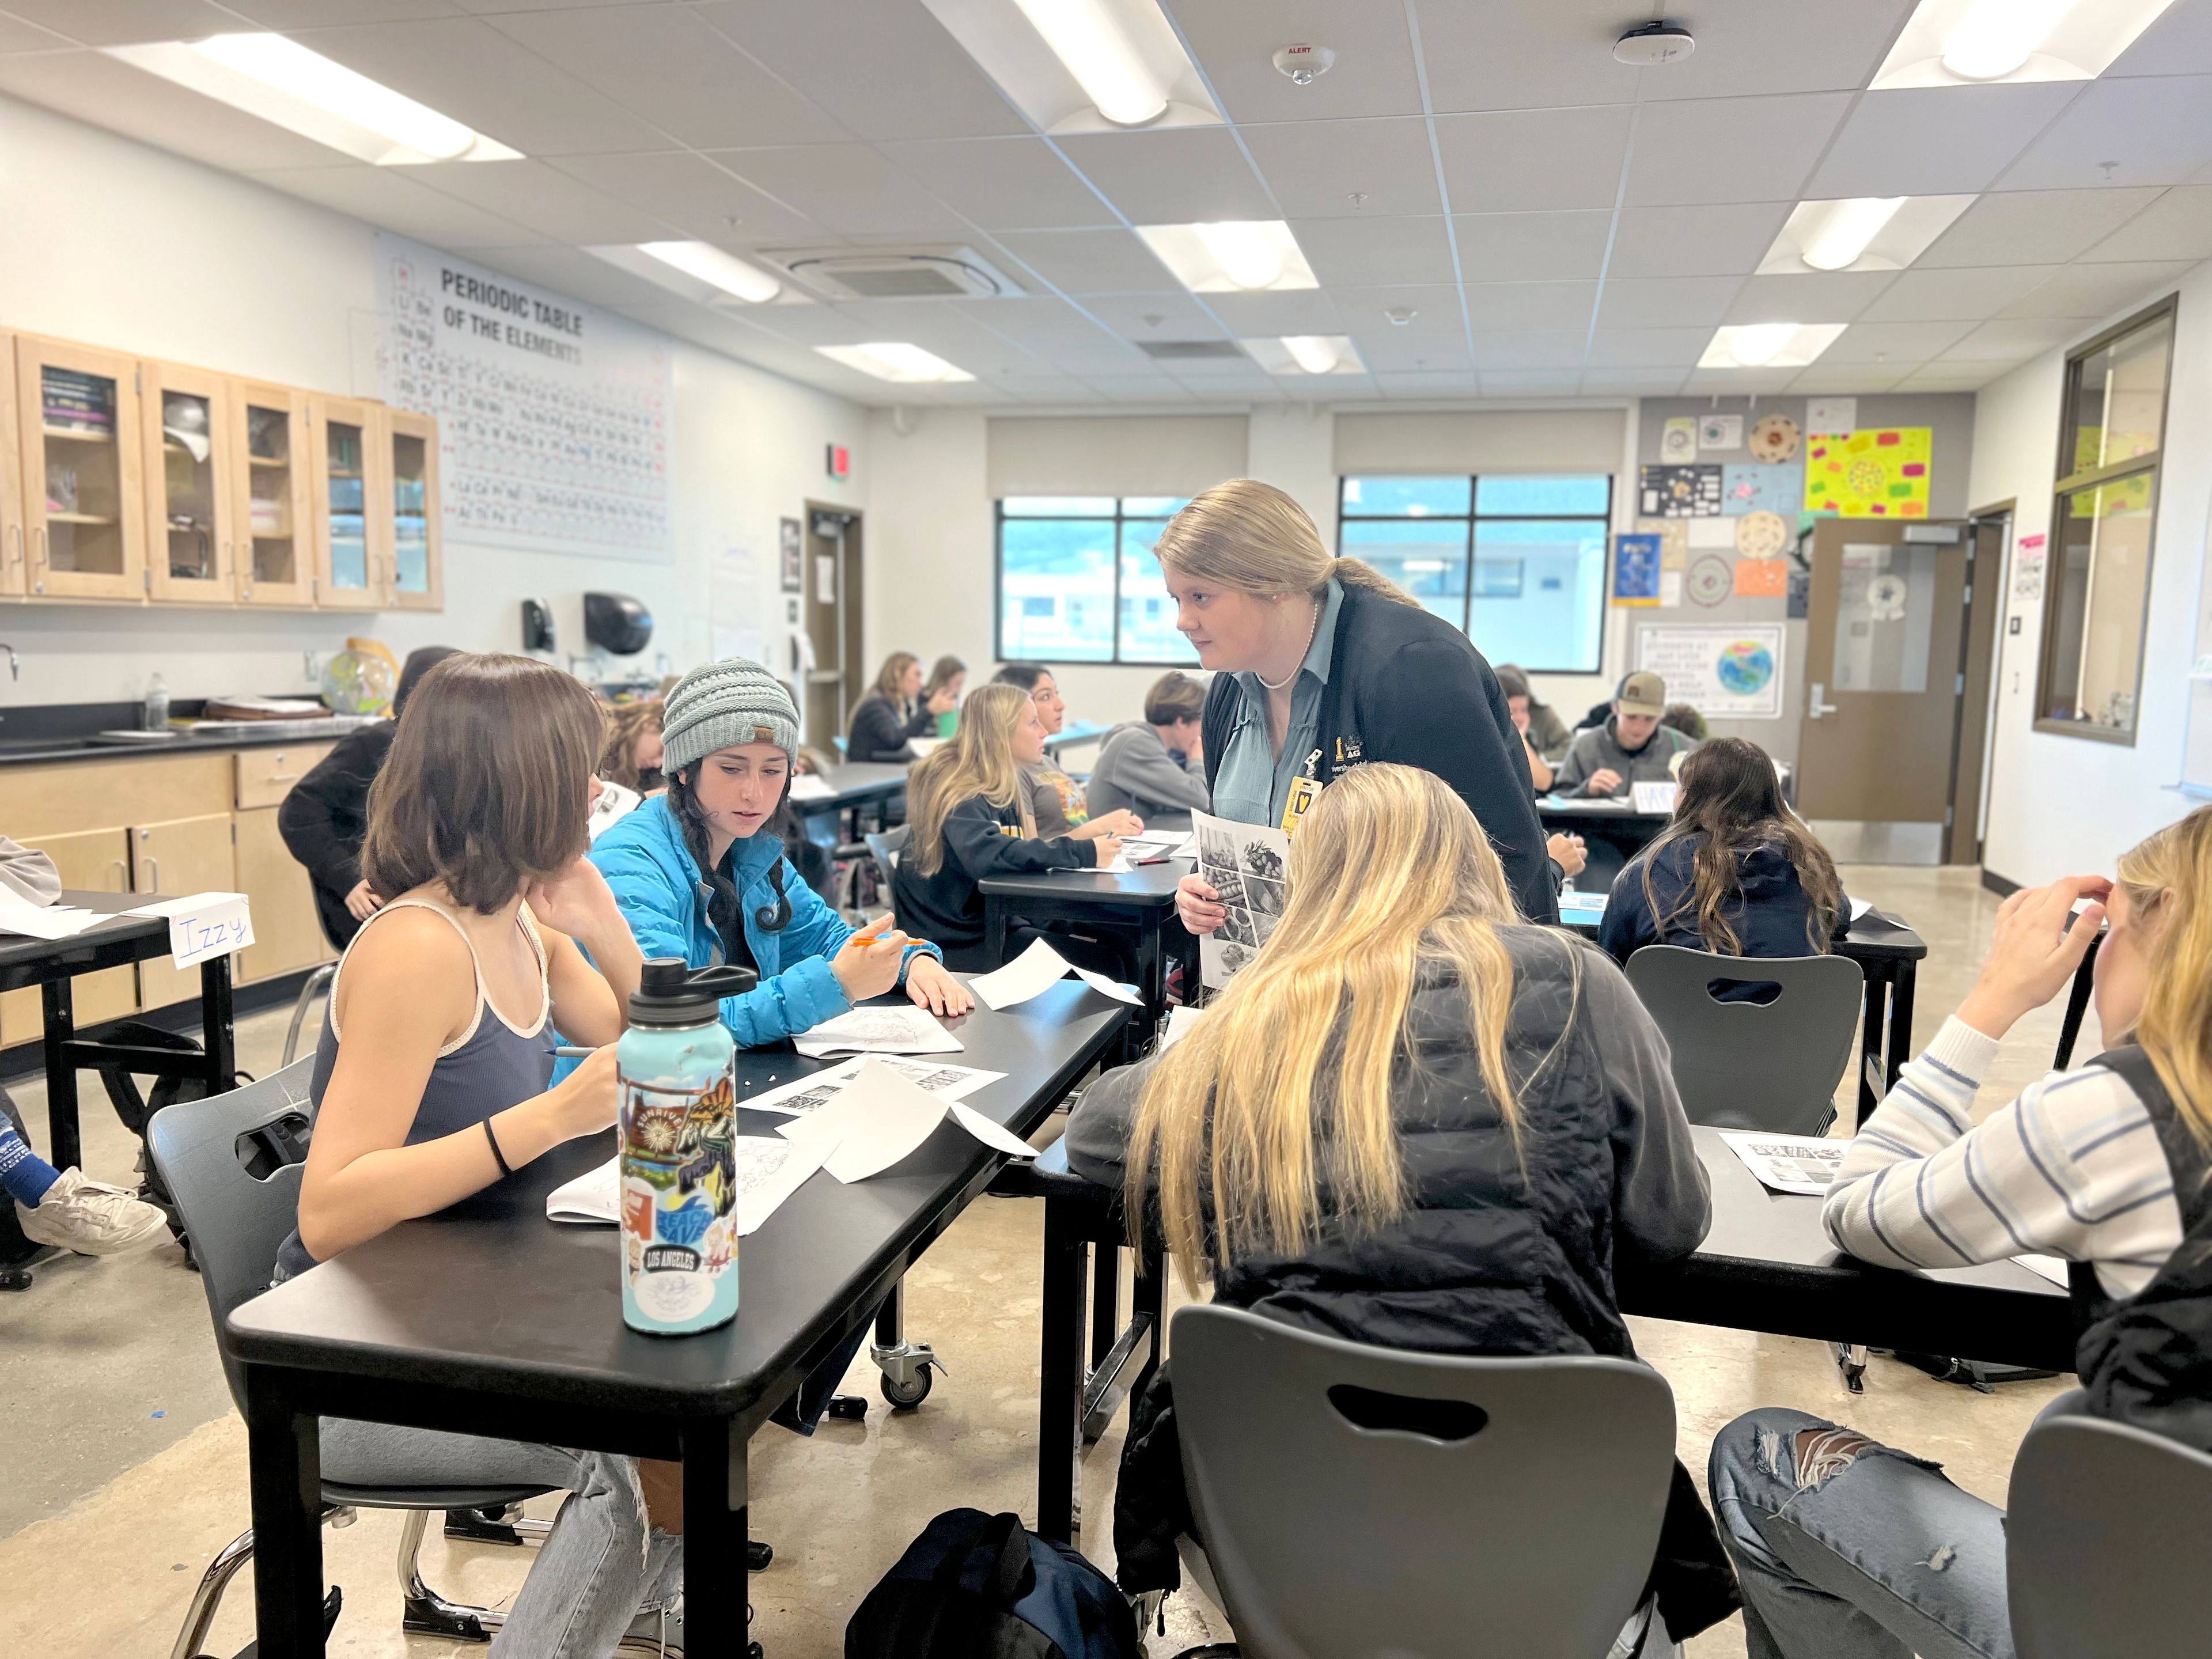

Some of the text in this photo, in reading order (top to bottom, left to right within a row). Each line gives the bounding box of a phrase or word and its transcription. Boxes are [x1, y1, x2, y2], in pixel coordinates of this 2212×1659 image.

[441, 267, 583, 338] PERIODIC TABLE
[443, 305, 582, 367] OF THE ELEMENTS
[1347, 749, 1361, 759] AG
[637, 1108, 683, 1130] SUNRIVE
[647, 1249, 694, 1271] LOS ANGELES
